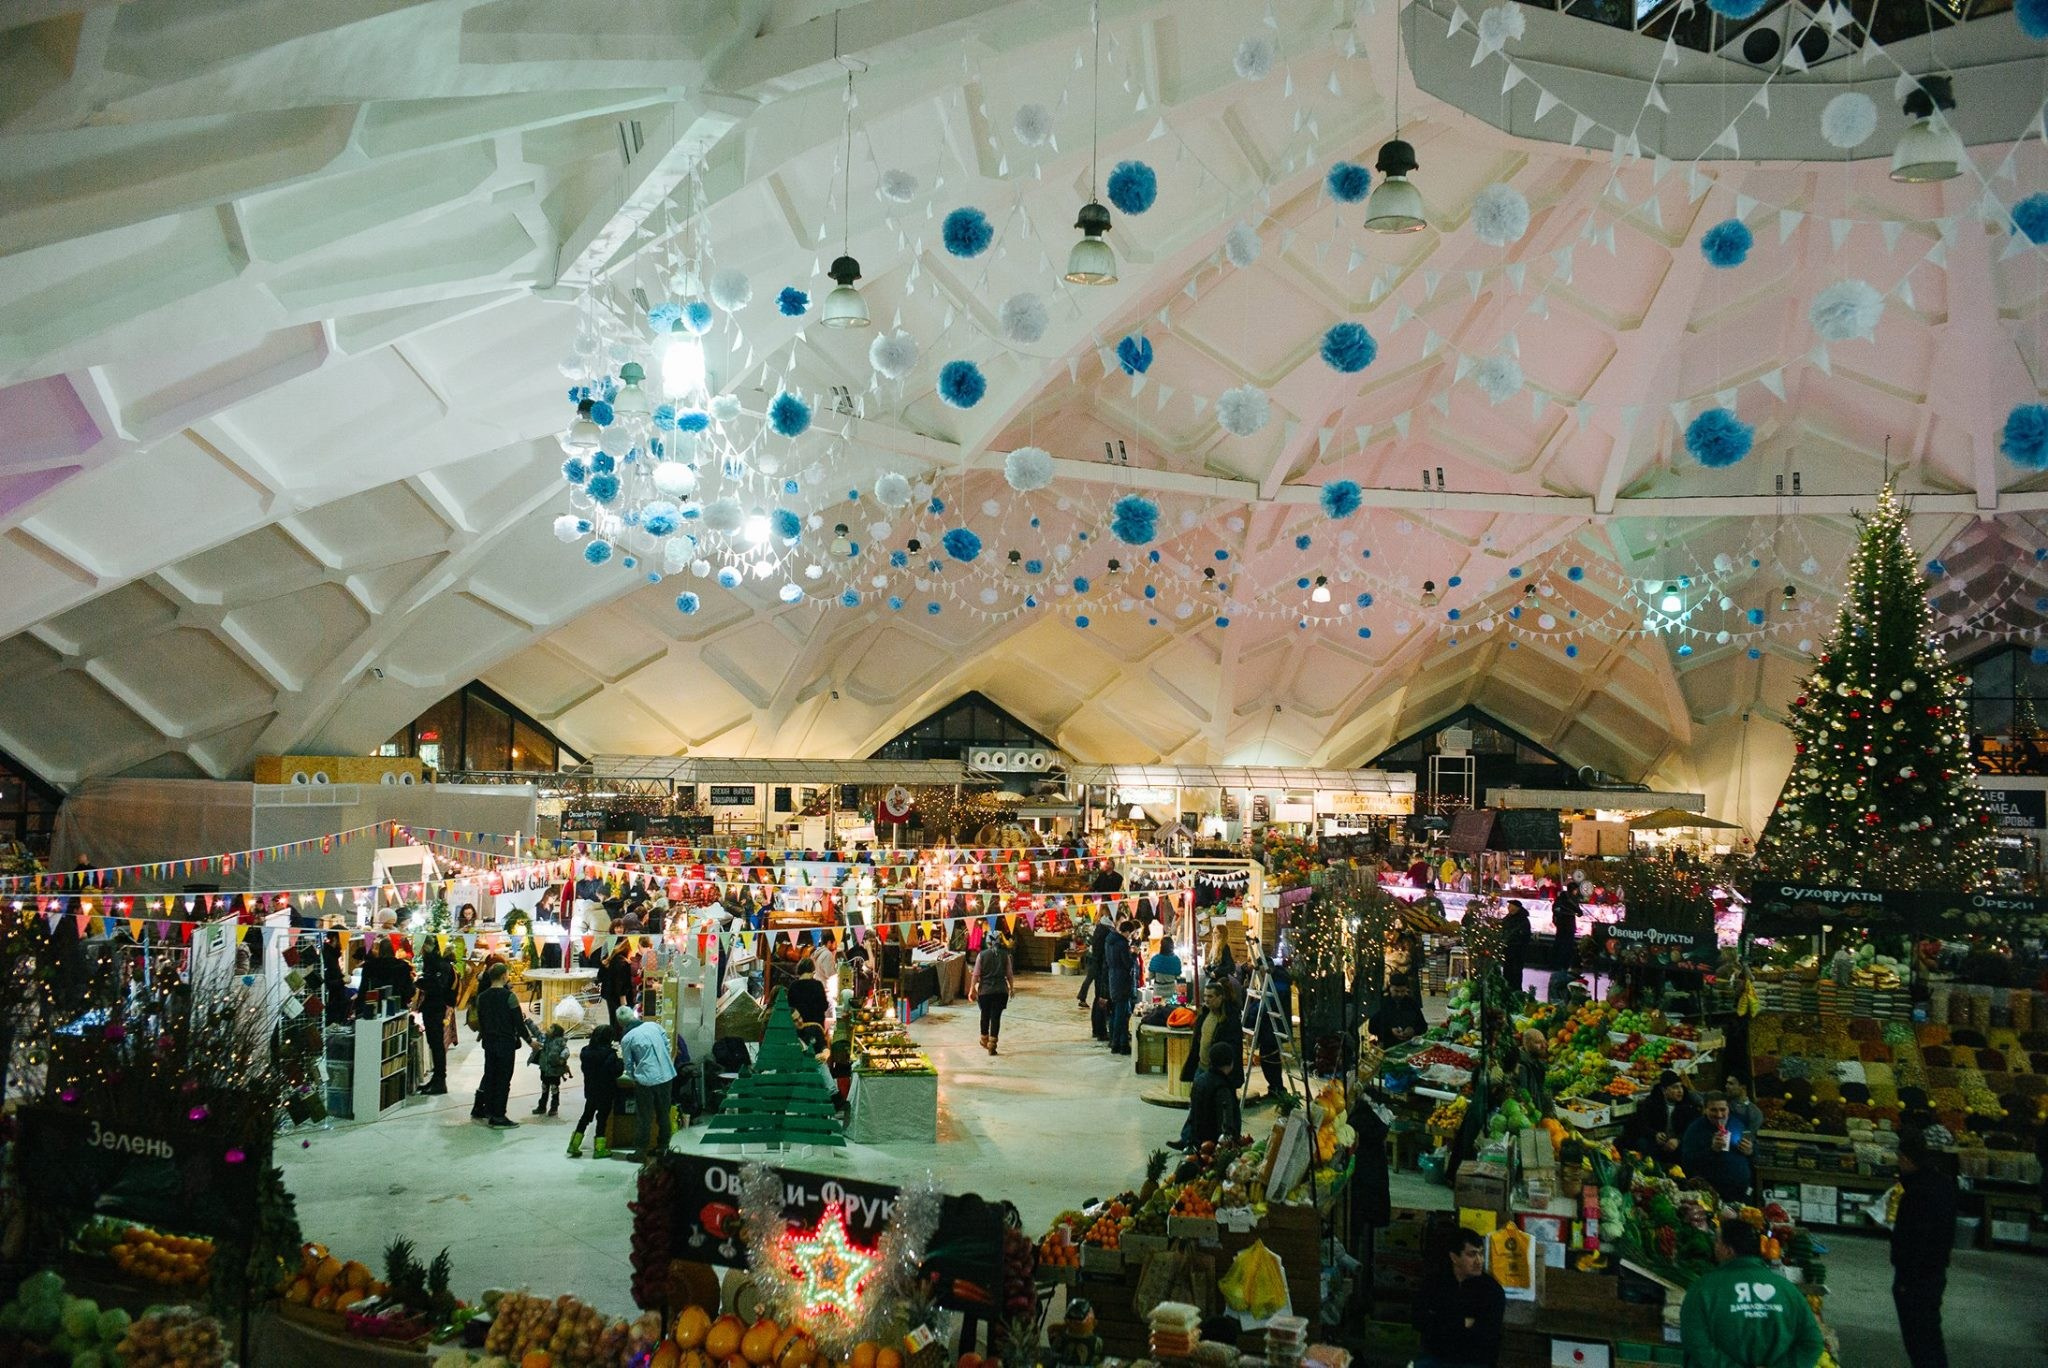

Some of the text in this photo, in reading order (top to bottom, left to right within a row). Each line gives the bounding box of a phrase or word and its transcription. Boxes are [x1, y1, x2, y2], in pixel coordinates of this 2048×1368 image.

[1990, 803, 2021, 815] МЕД
[1780, 886, 1883, 903] Сухофрукты
[1607, 925, 1694, 945] Овощи-Фрукты
[86, 1120, 174, 1159] Зелень
[704, 1166, 897, 1229] Ови-Фрук
[1734, 1282, 1752, 1303] Я
